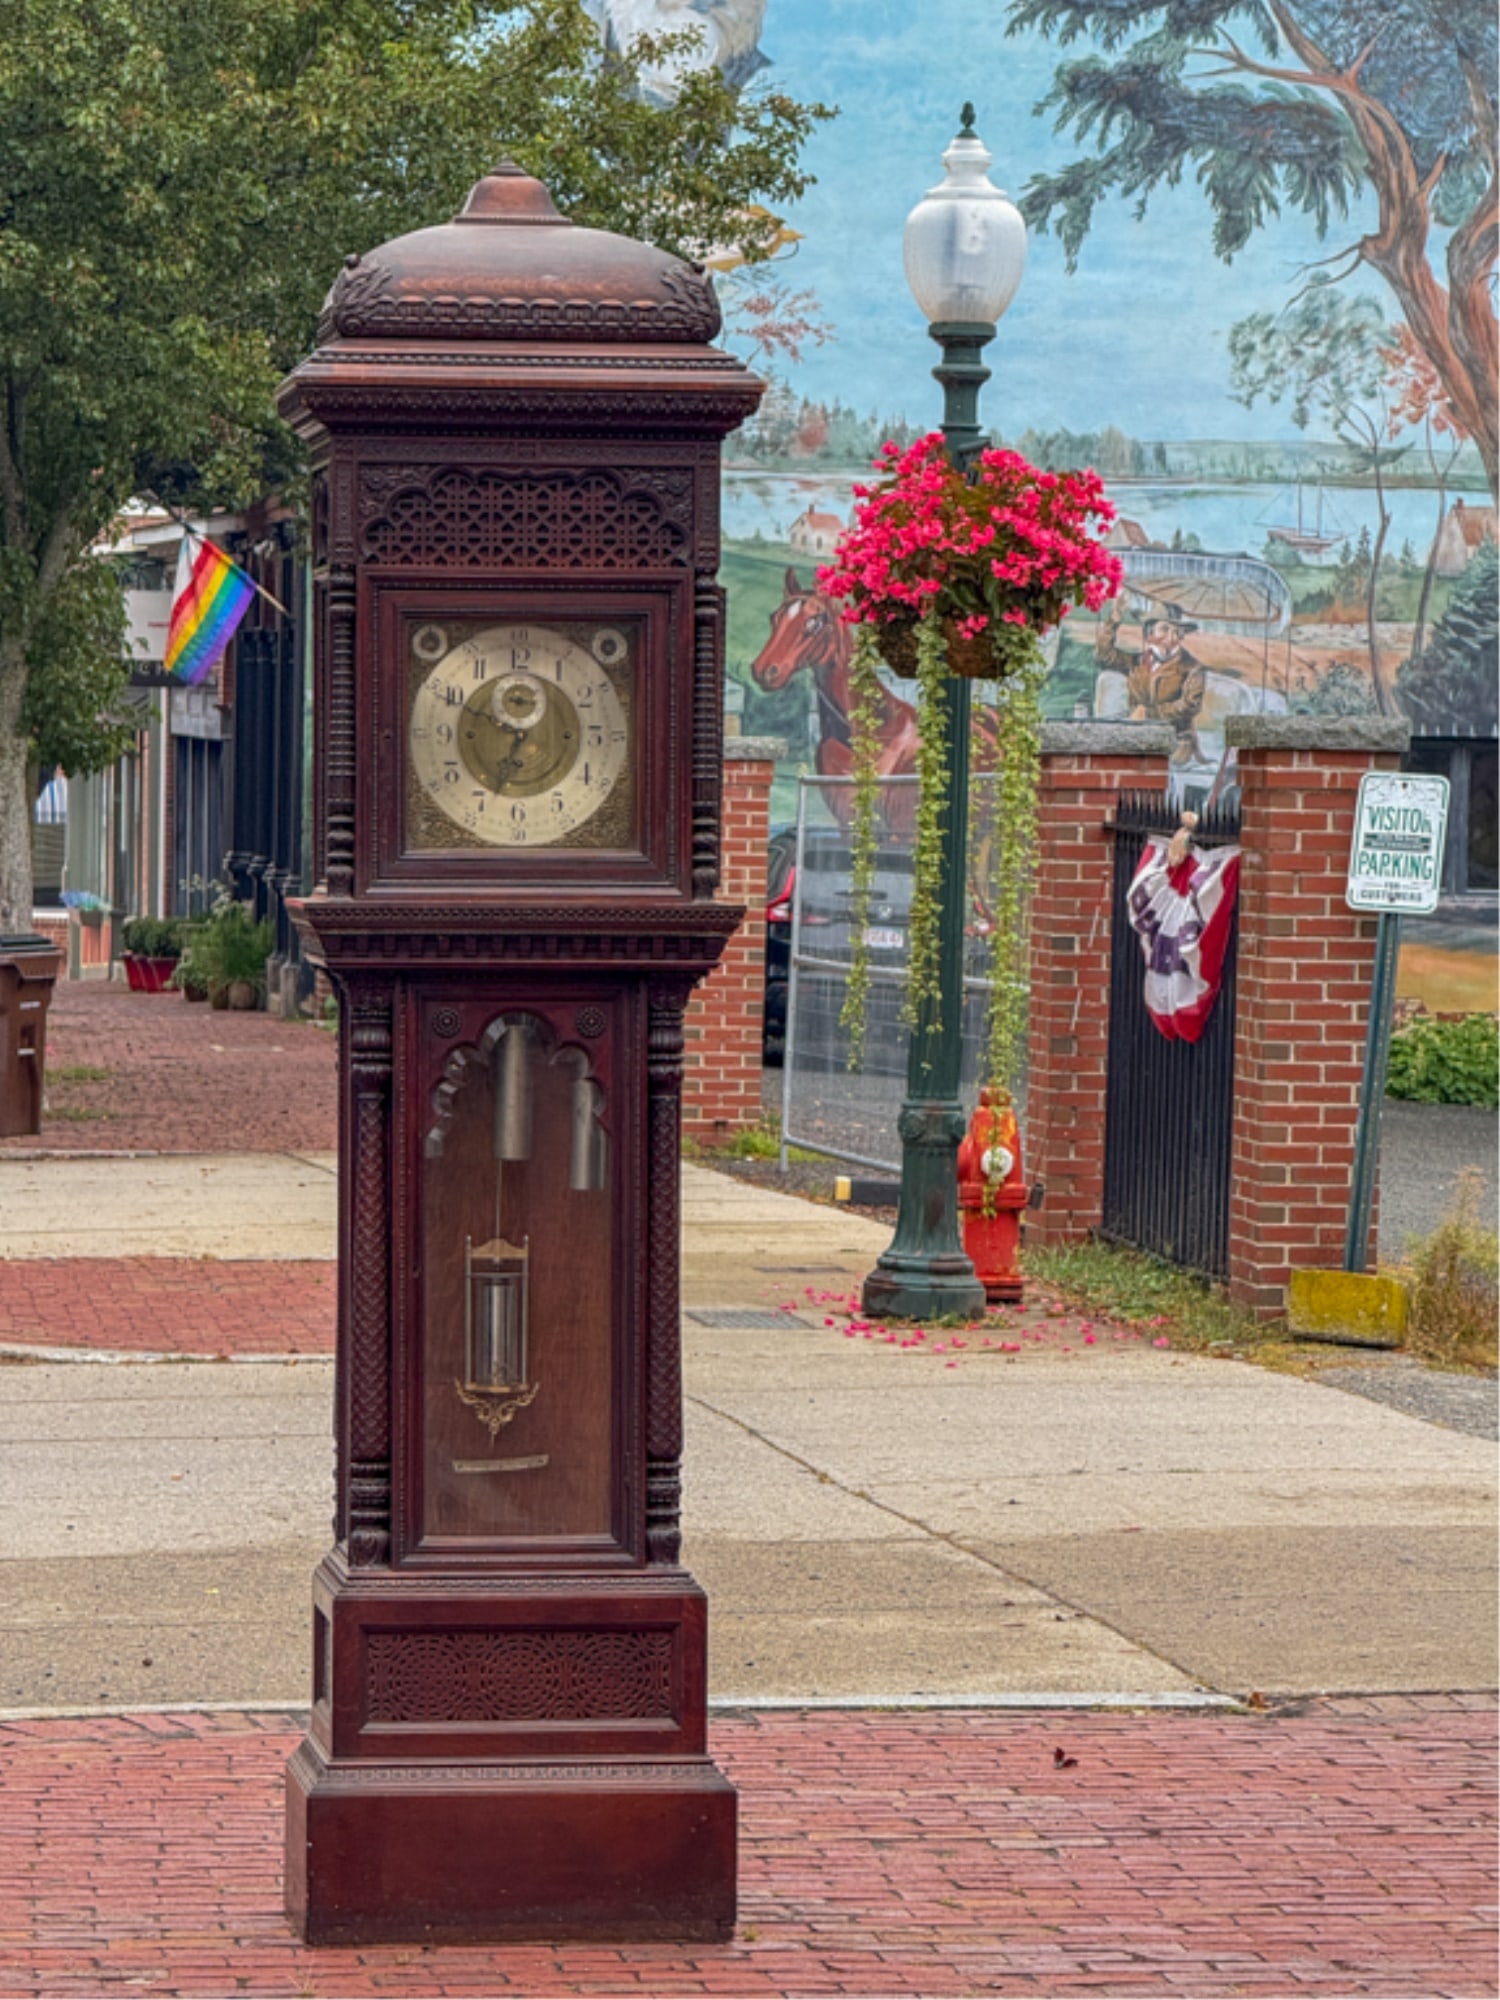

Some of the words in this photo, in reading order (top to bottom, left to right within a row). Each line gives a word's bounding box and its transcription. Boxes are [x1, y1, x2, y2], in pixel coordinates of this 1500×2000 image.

[473, 658, 487, 680] 11
[511, 648, 531, 670] 12
[556, 660, 563, 682] 1
[447, 686, 464, 706] 10
[577, 685, 593, 708] 2
[436, 724, 452, 743] 9
[587, 725, 602, 747] 3
[444, 761, 460, 784] 8
[576, 762, 592, 786] 4
[472, 790, 485, 812] 7
[511, 801, 525, 823] 6
[551, 791, 563, 813] 5
[1358, 851, 1433, 880] PARKING
